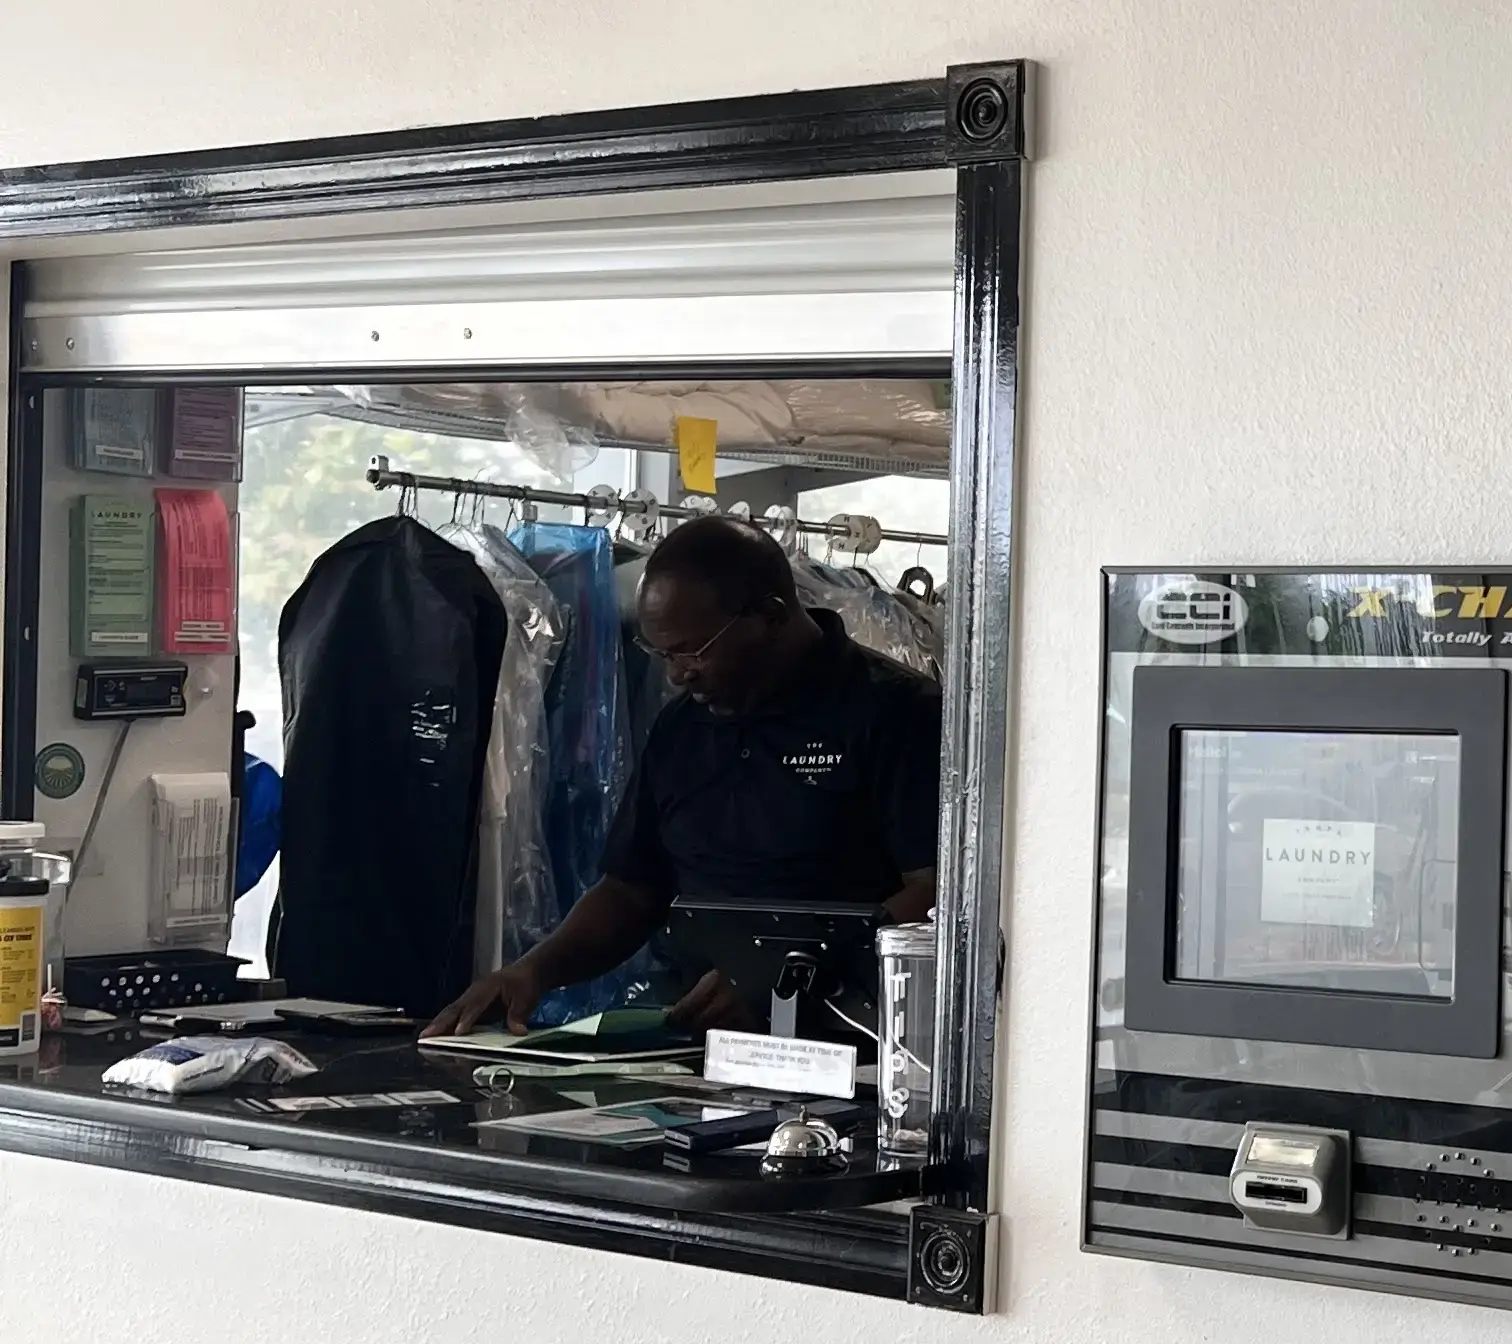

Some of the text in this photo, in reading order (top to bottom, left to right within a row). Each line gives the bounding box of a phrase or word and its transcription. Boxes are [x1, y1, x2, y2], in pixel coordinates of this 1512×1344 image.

[1423, 630, 1492, 646] Totally
[783, 755, 842, 764] LAUNDRY
[1265, 847, 1371, 865] LAUNDRY
